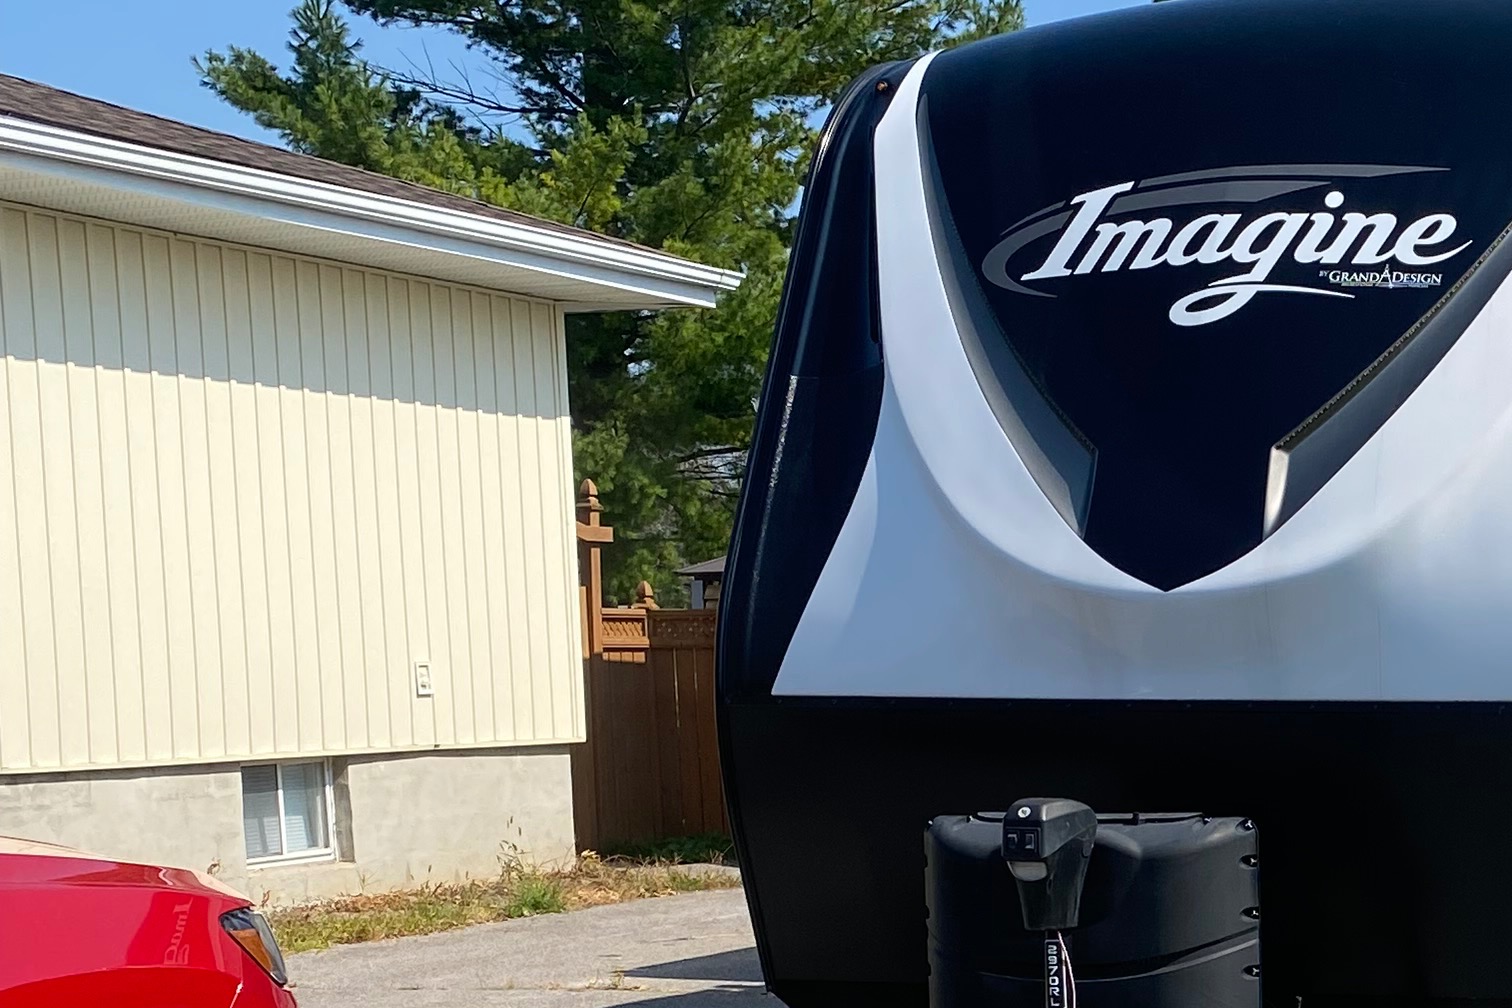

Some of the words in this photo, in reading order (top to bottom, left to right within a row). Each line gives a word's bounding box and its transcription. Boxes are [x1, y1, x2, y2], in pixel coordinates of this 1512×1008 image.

[1020, 180, 1474, 326] Imagine
[1328, 270, 1379, 283] GRAND
[1392, 271, 1443, 284] DESIGN
[1047, 944, 1061, 1007] 2970RL
